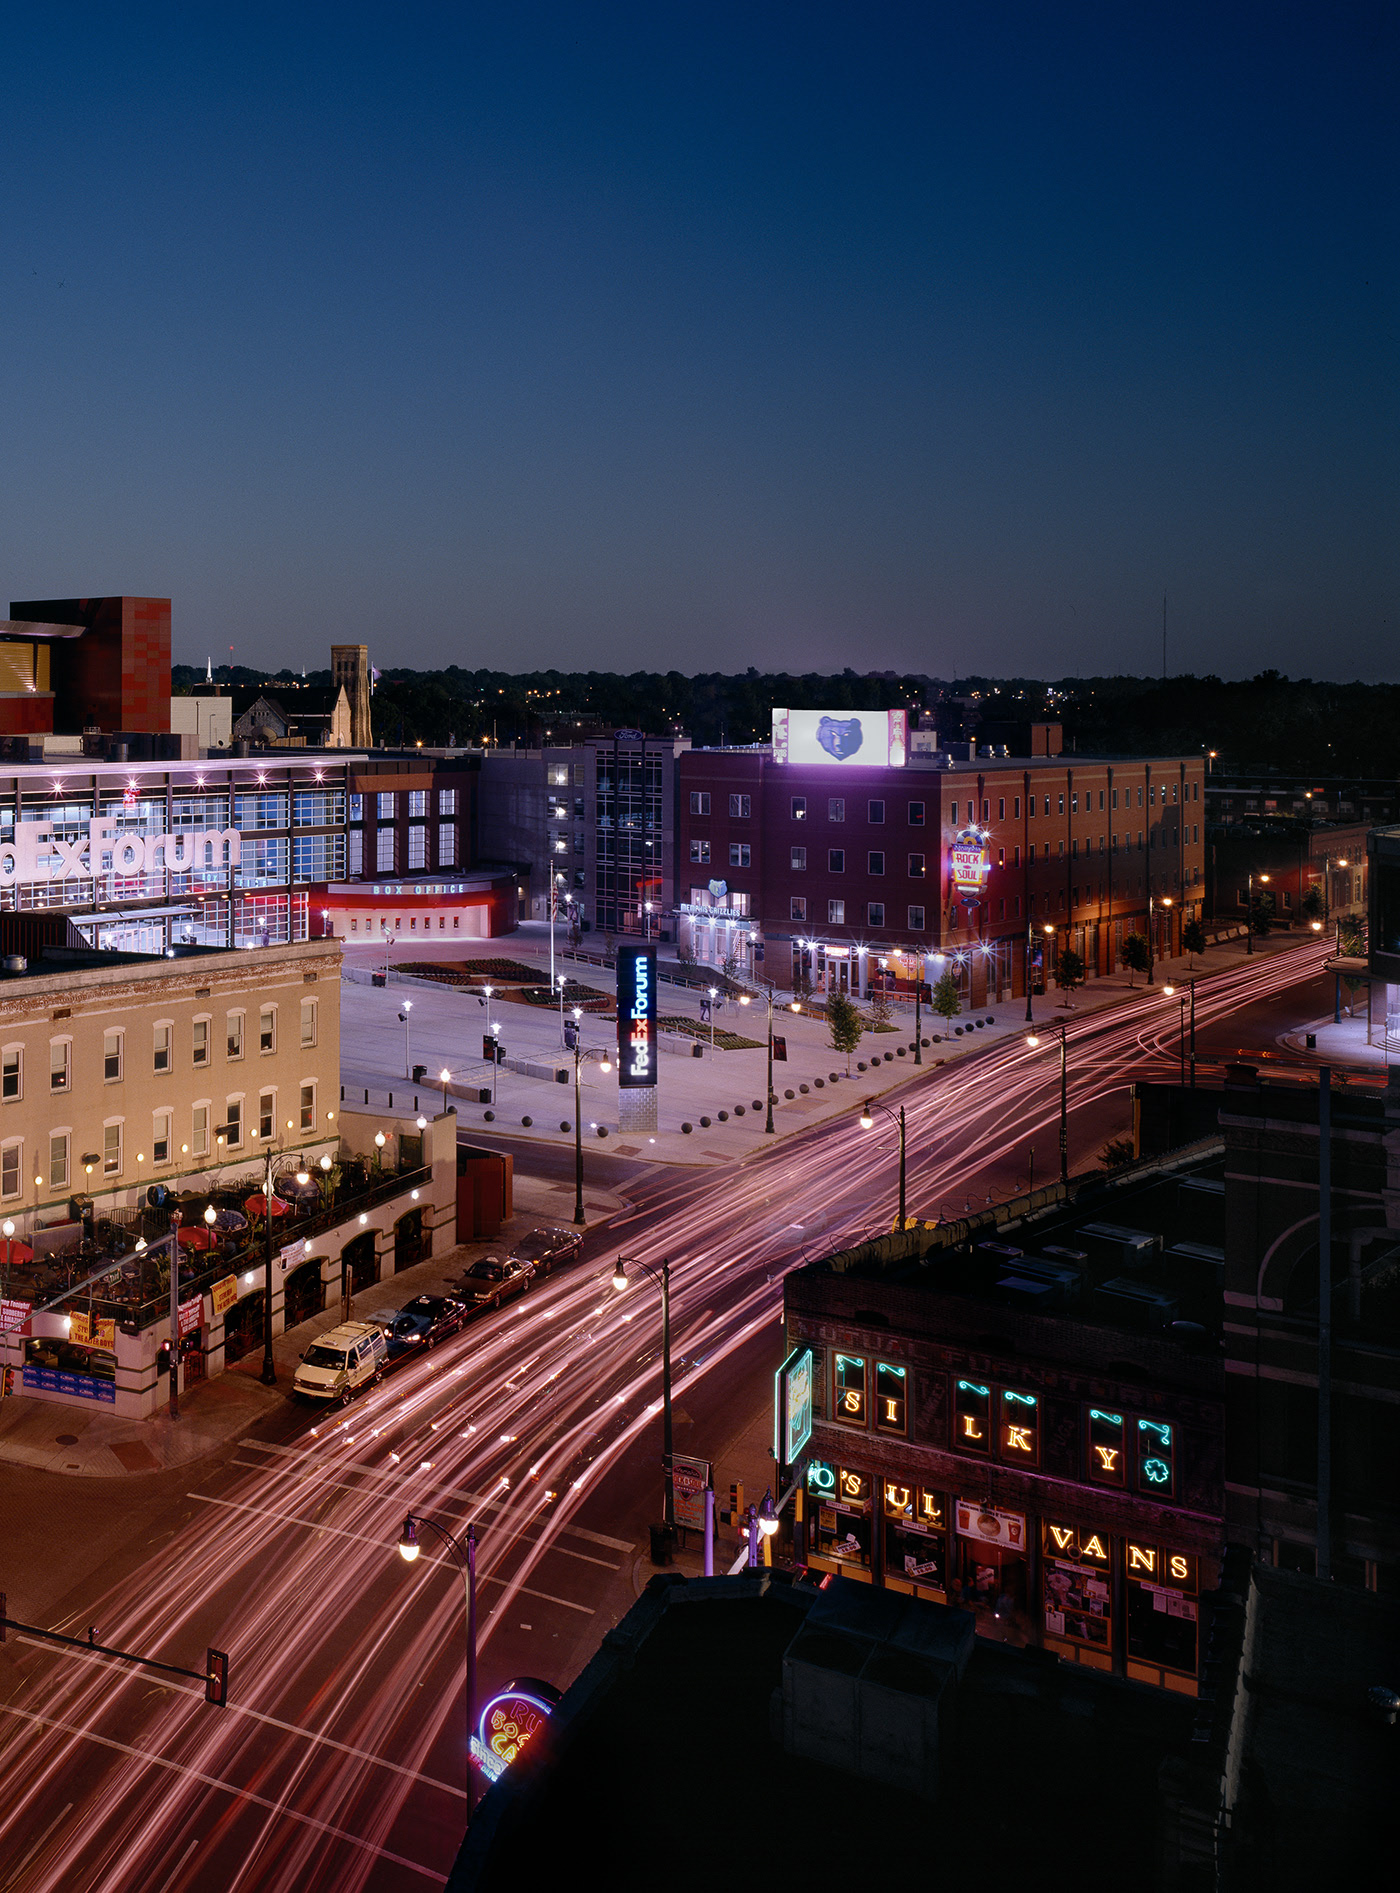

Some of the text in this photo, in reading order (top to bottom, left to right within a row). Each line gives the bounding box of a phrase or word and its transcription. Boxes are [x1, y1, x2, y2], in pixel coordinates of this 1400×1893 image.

[956, 853, 979, 864] ROCK
[957, 869, 977, 880] SOUL
[373, 884, 464, 895] BOX OFFICE
[680, 903, 741, 917] MEMPHIS GRIZZLIES
[631, 956, 648, 1076] FedExForum
[959, 1502, 979, 1512] Welcome
